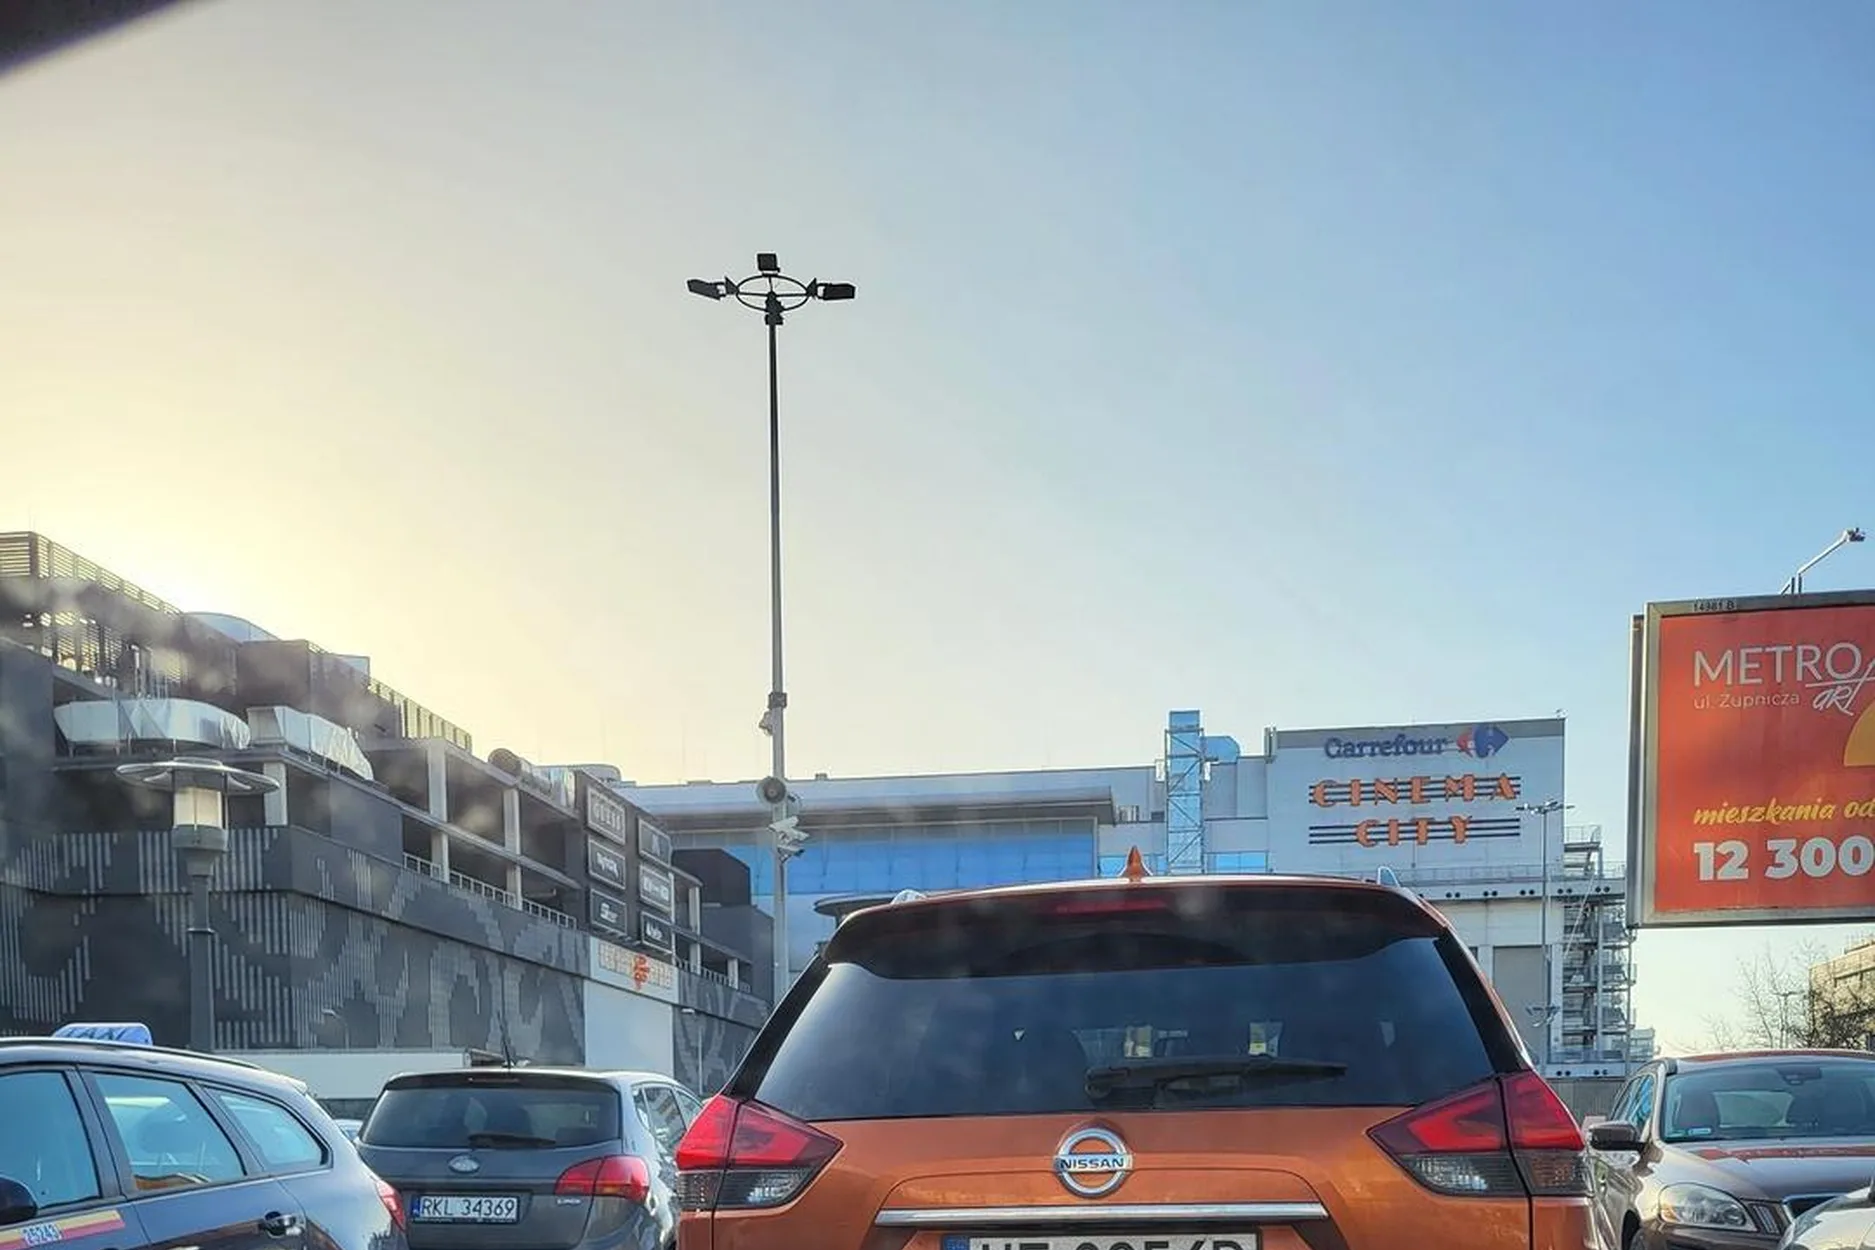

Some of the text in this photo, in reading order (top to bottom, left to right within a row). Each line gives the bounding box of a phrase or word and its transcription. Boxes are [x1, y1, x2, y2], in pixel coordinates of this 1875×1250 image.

[1694, 642, 1862, 687] METRO
[1324, 733, 1449, 760] Carrefour
[1312, 773, 1517, 808] CINEMA
[1694, 797, 1875, 825] mieszkania od
[1355, 815, 1473, 848] CITY
[1694, 835, 1875, 882] 12 300
[1060, 1157, 1125, 1171] NISSAN
[421, 1198, 516, 1217] RKL 34369
